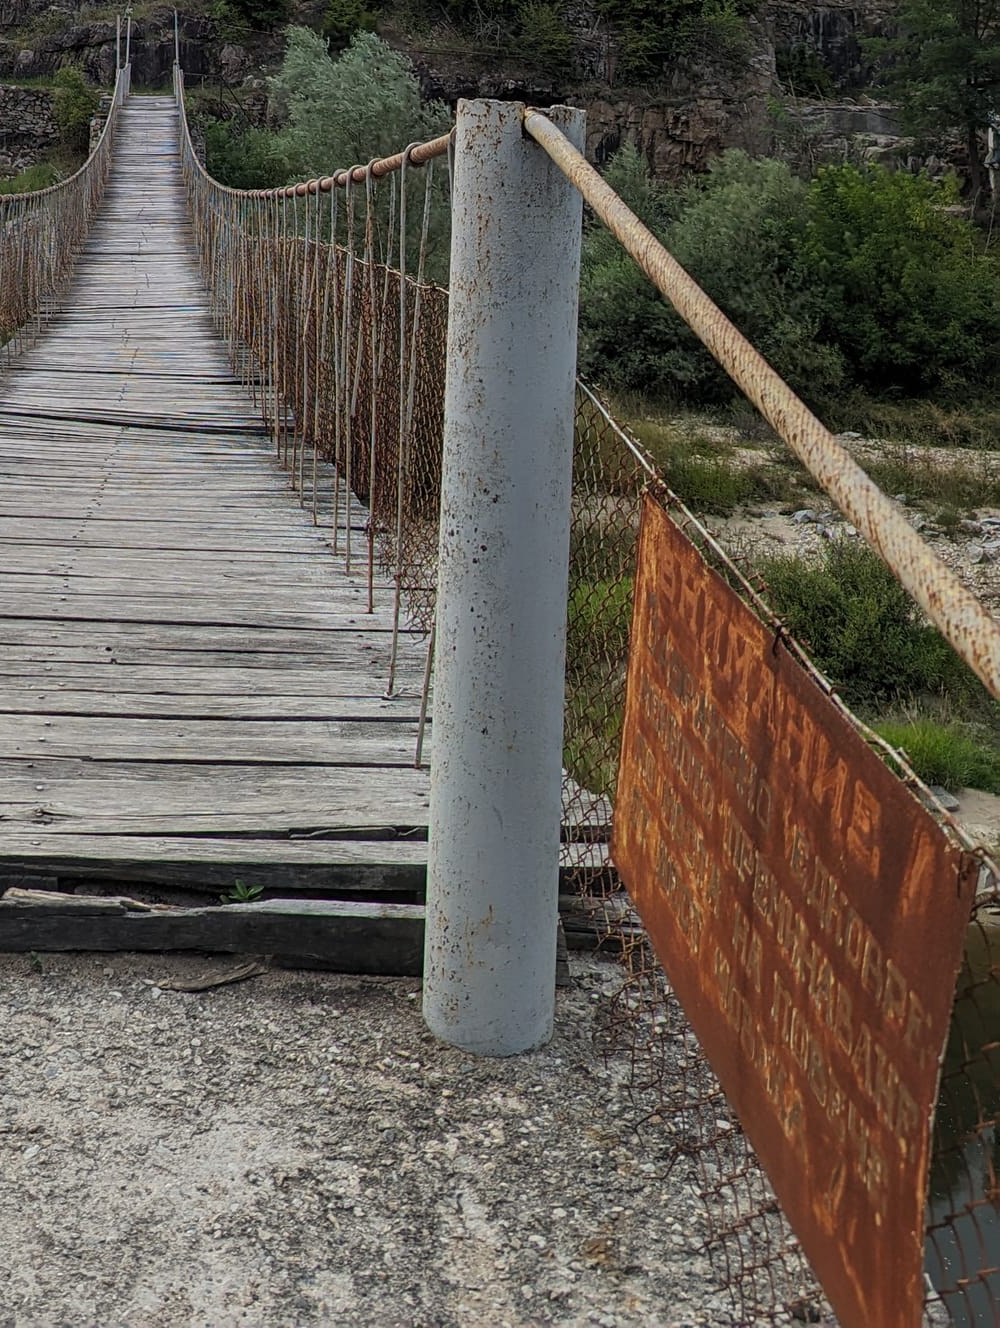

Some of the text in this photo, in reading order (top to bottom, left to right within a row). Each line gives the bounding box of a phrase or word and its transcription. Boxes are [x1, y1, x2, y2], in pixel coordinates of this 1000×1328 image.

[658, 545, 886, 883] ВНИМАНИЕ
[722, 802, 920, 1169] ПРЕМИНАВАНЕ
[730, 896, 764, 997] НА
[769, 967, 889, 1221] ПОВЕЧЕ
